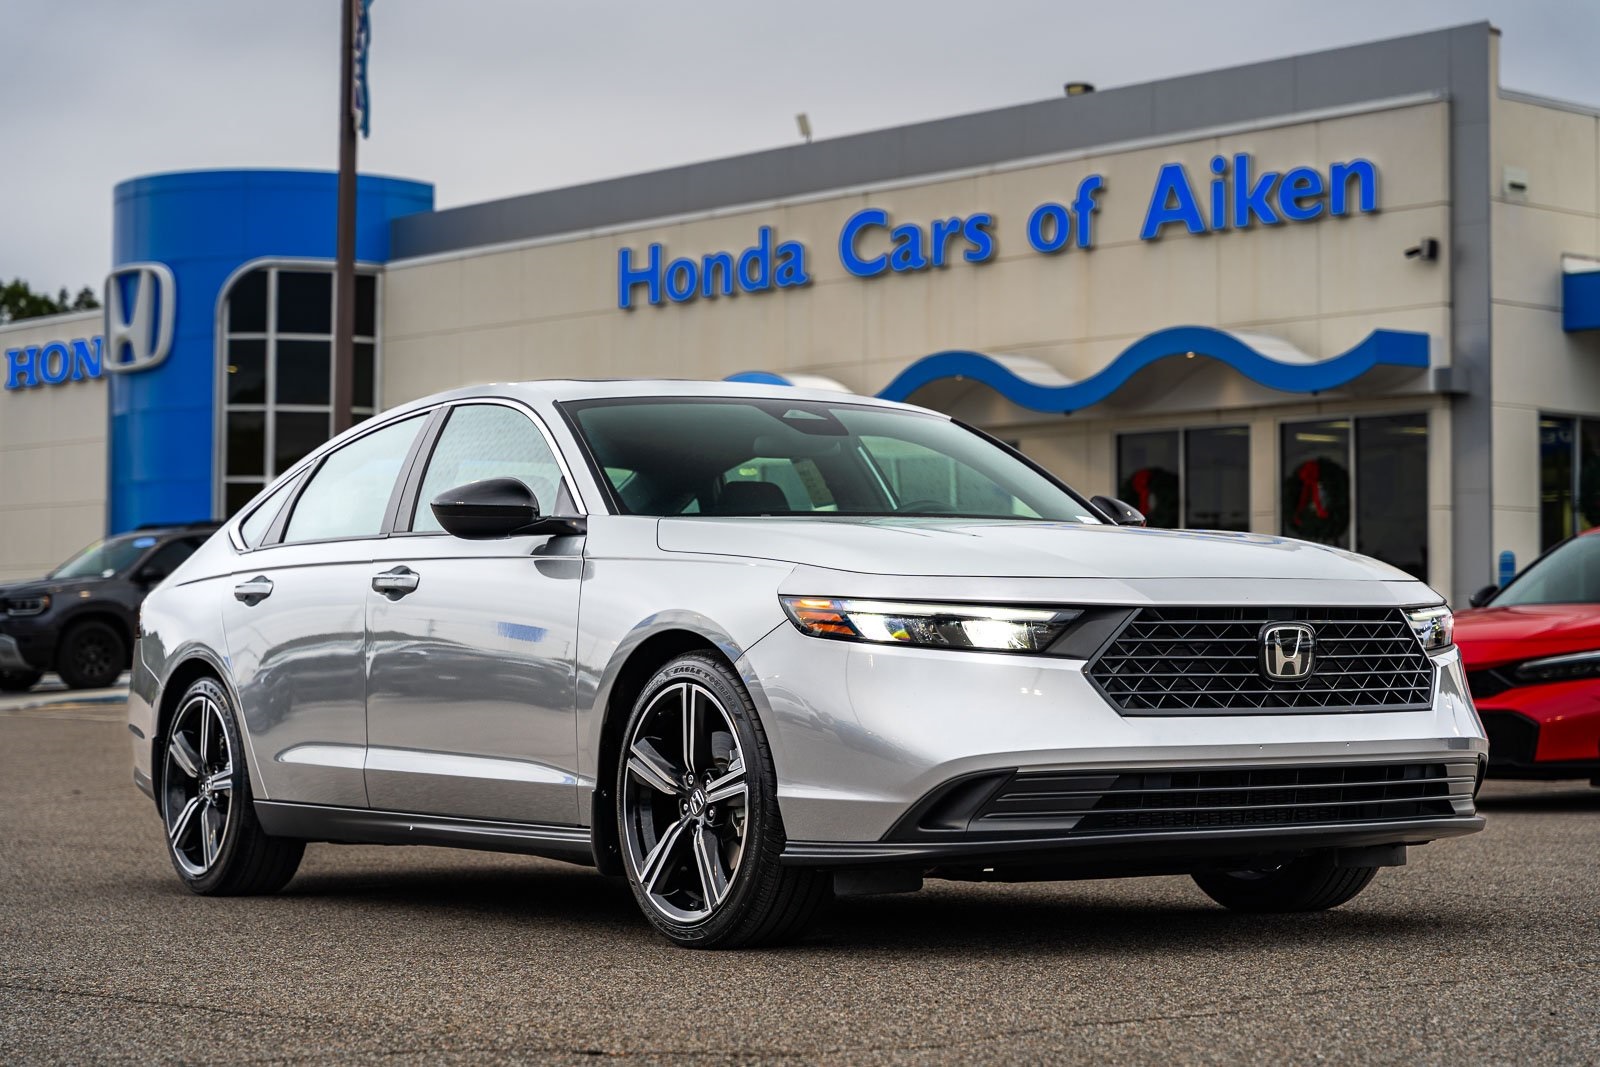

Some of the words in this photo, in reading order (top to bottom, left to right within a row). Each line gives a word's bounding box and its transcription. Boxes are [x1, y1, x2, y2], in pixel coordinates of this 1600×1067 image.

[618, 225, 809, 309] Honda
[838, 207, 994, 278] Cars
[1026, 173, 1104, 254] of
[1139, 152, 1378, 241] Aiken
[5, 335, 104, 390] HON
[673, 666, 702, 676] EAGLE
